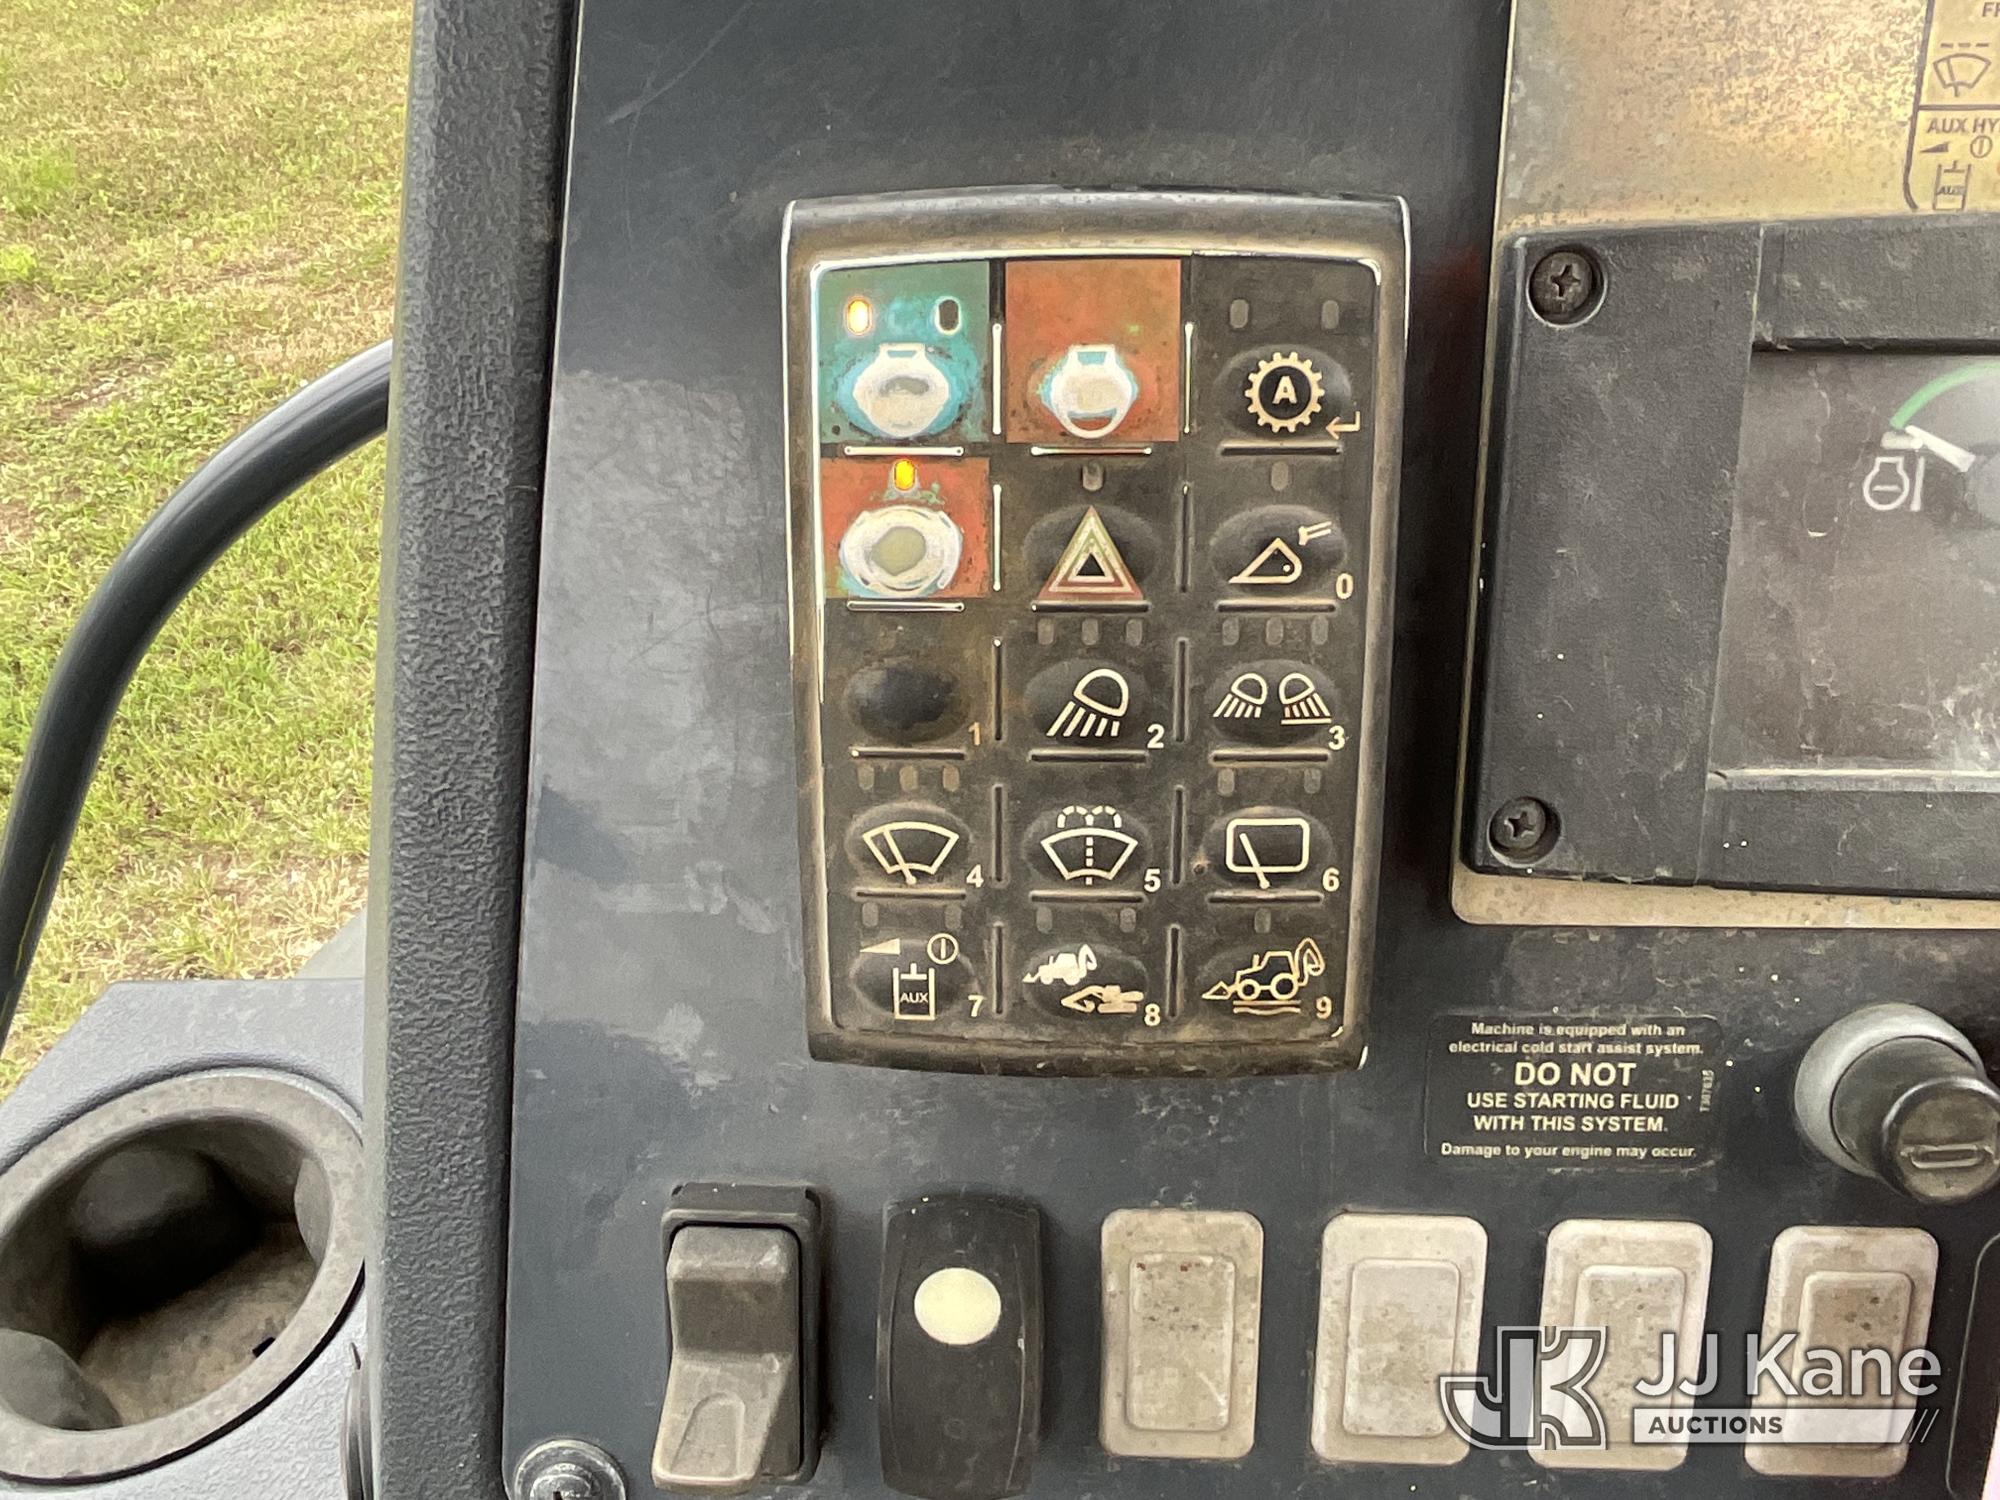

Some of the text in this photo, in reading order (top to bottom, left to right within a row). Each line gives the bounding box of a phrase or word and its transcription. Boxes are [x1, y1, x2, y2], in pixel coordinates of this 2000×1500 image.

[1927, 118, 2000, 134] AUX HY
[1271, 376, 1298, 405] A
[968, 723, 981, 746] 1
[1146, 725, 1165, 749] 2
[1328, 725, 1346, 750] 3
[966, 865, 984, 888] 4
[1144, 869, 1162, 892] 5
[1322, 868, 1340, 892] 6
[900, 992, 928, 1005] AUX
[968, 995, 984, 1017] 7
[1315, 998, 1332, 1020] 9
[1144, 1003, 1161, 1027] 8
[1471, 1022, 1685, 1039] Machine is equipped with an
[1448, 1041, 1704, 1057] electrical cold start assist system.
[1514, 1062, 1637, 1087] DO NOT
[1467, 1092, 1679, 1110] USE STARTING FLUID
[1473, 1115, 1668, 1133] WITH THIS SYSTEM.
[1441, 1143, 1697, 1160] Damage to your engine may occur.
